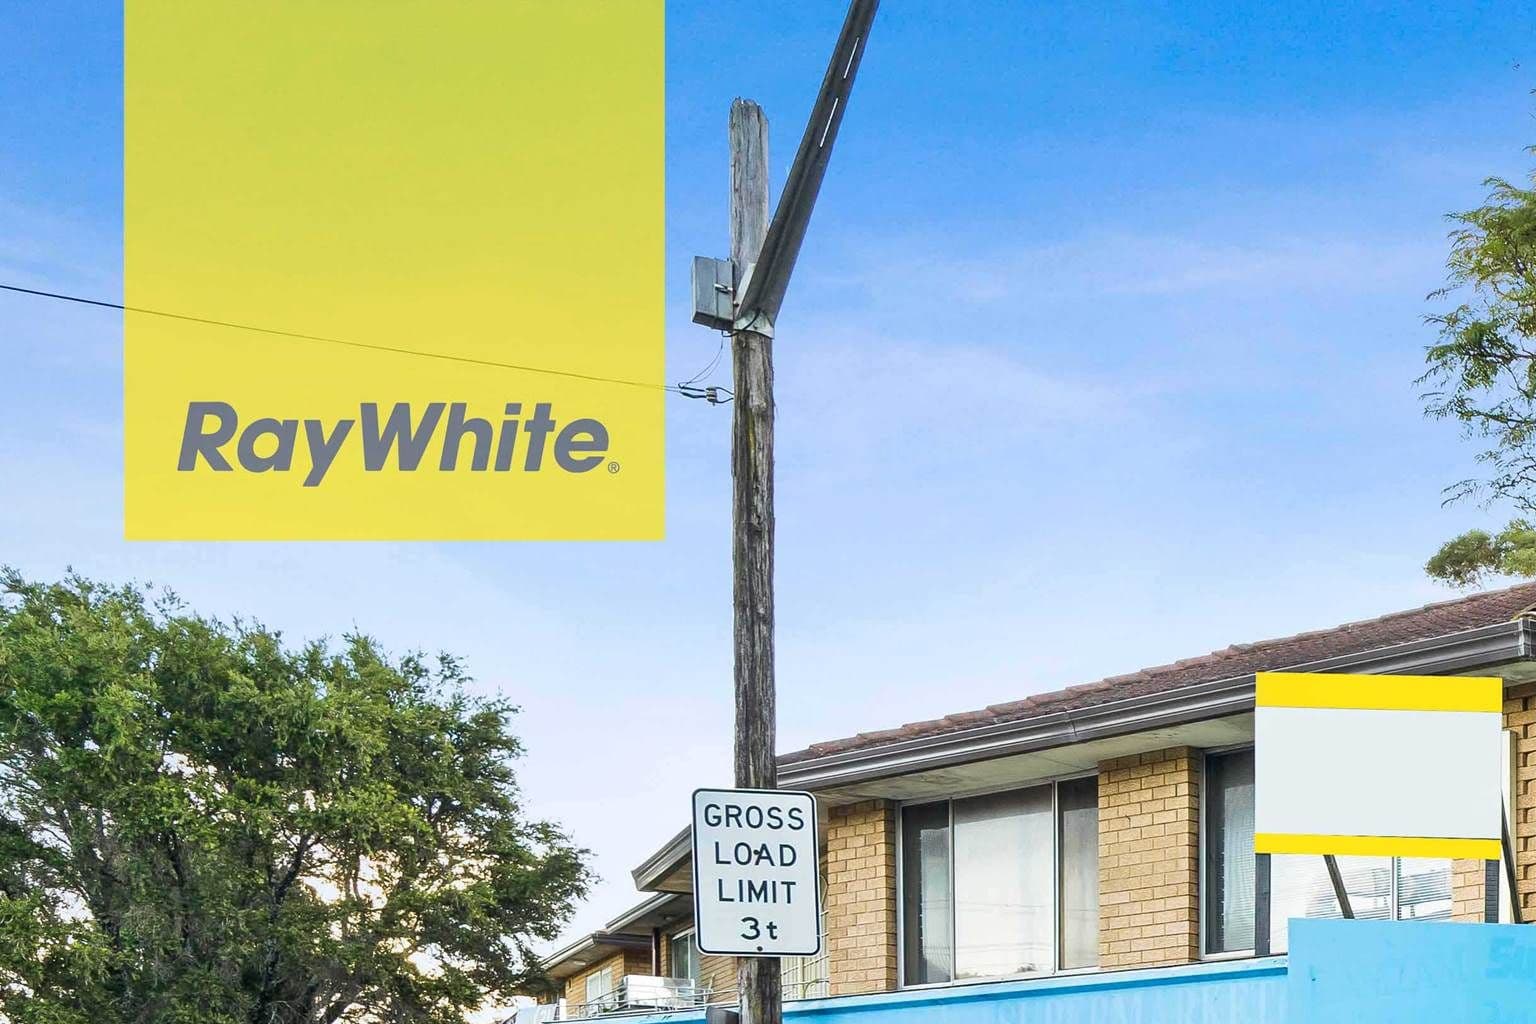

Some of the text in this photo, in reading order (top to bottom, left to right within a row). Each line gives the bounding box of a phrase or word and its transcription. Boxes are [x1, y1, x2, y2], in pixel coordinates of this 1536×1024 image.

[704, 803, 805, 830] GROSS
[714, 841, 797, 867] LOAD
[718, 878, 797, 904] LIMIT
